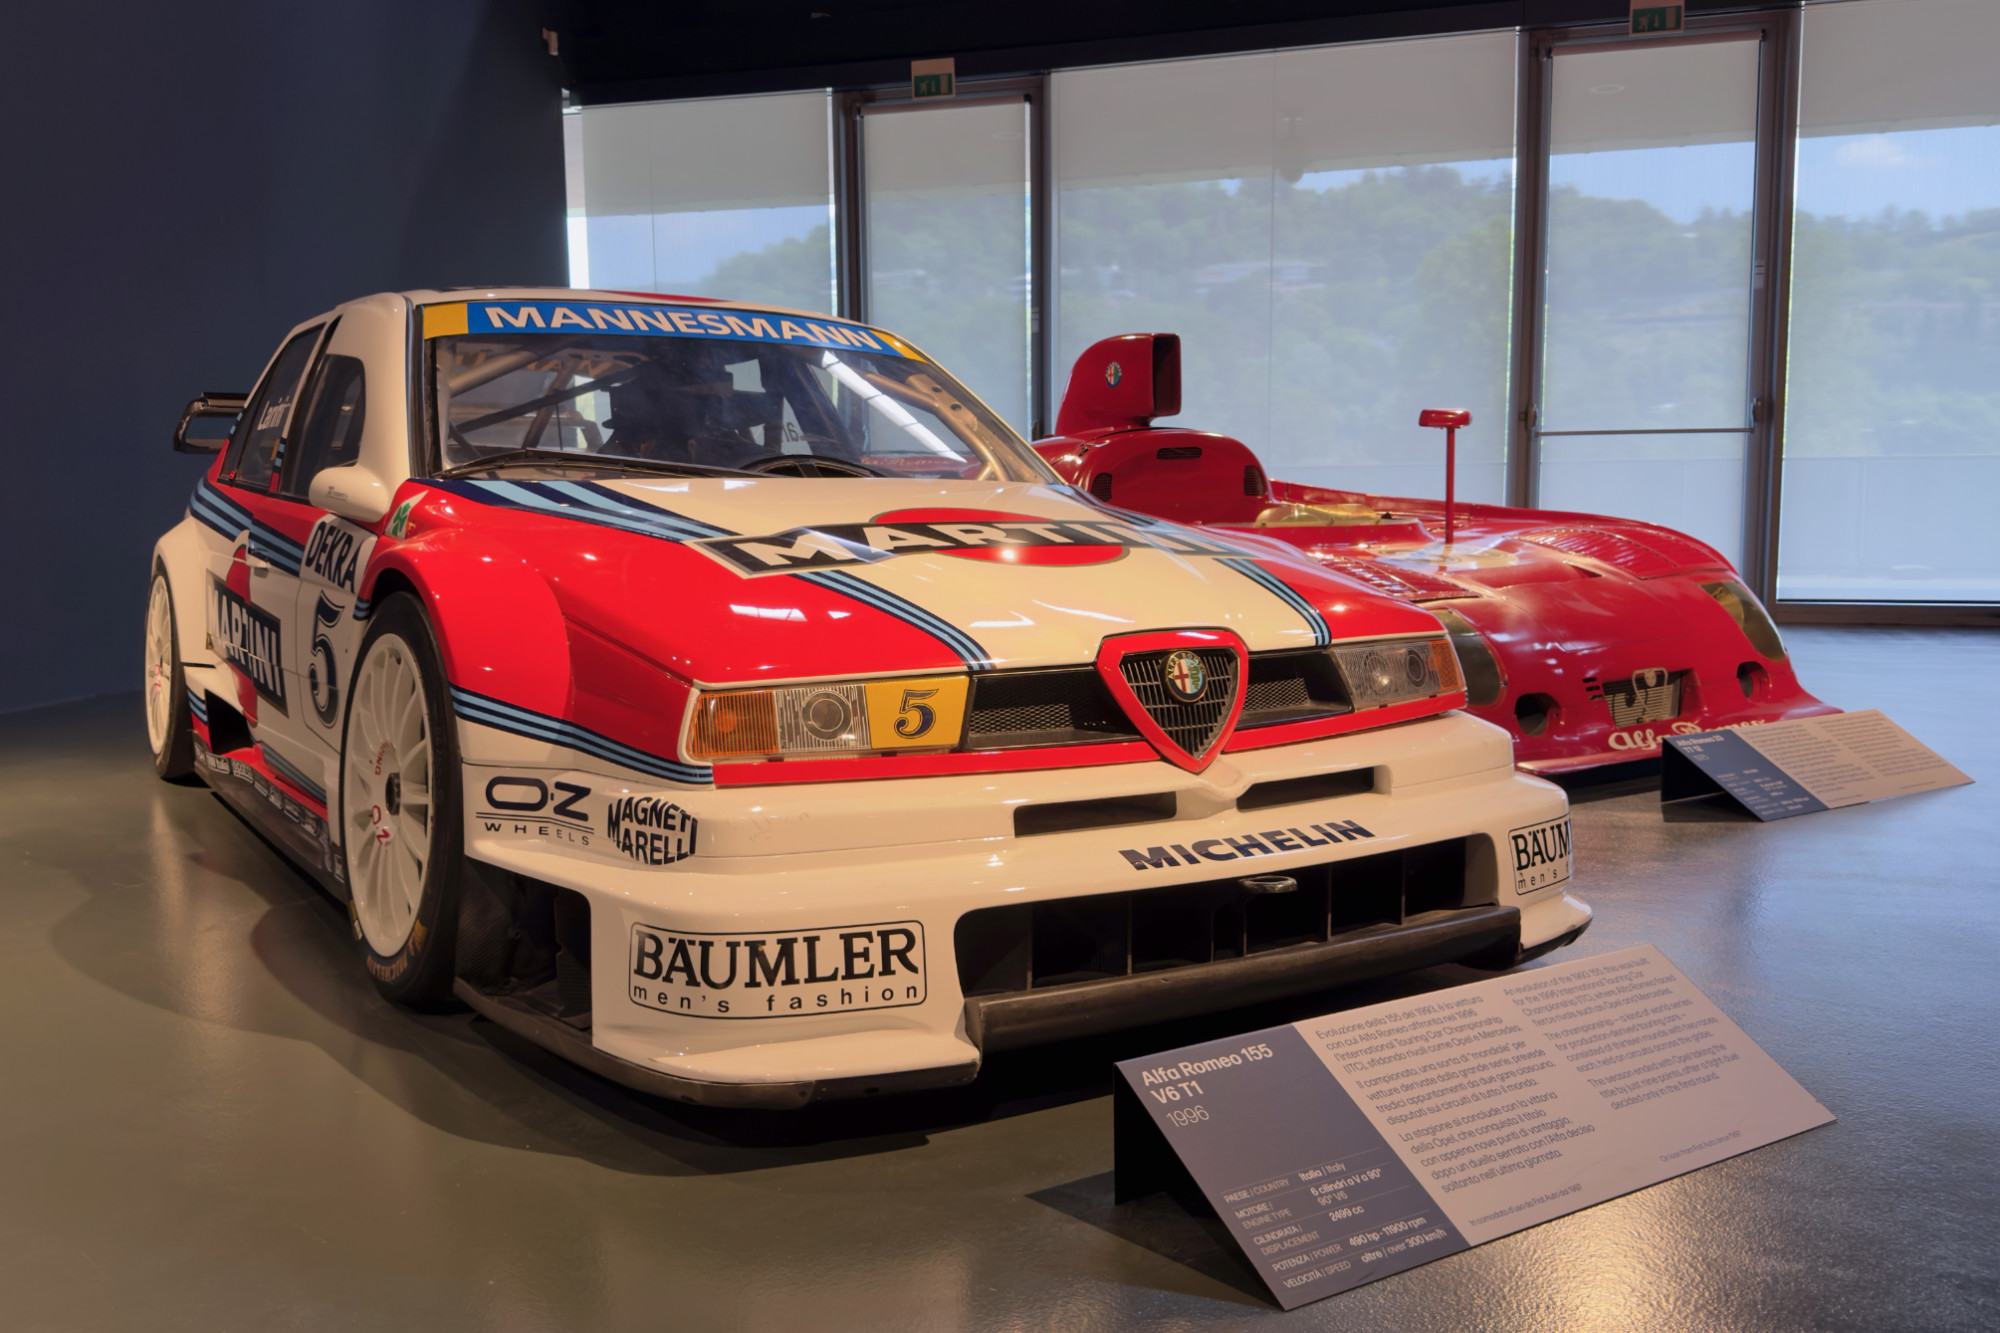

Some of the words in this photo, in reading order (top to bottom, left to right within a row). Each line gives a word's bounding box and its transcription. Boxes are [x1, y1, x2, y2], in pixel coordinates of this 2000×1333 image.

[485, 306, 883, 350] MANNESMANN
[305, 521, 357, 594] DEKRA
[735, 520, 1229, 567] MARTINI
[207, 583, 286, 699] MARTINI
[308, 590, 346, 728] 5
[893, 688, 939, 740] 5
[484, 822, 590, 847] WHEELS
[607, 797, 698, 843] MAGNETI
[607, 812, 698, 865] MARELLI
[1119, 820, 1376, 871] MICHELIN
[632, 926, 920, 989] BÄUMLER
[632, 983, 730, 1014] men's
[767, 984, 919, 1011] fashion
[1142, 1068, 1180, 1086] Alfa
[1179, 1054, 1242, 1076] Romeo
[1241, 1044, 1273, 1062] 155
[1151, 1086, 1181, 1103] V6
[1179, 1081, 1203, 1097] T1
[1413, 1122, 1452, 1137] stagione
[1461, 1108, 1501, 1123] conclude
[1501, 1103, 1518, 1112] con
[1526, 1091, 1557, 1104] vittoria
[1168, 1106, 1210, 1127] 1996
[1409, 1142, 1434, 1154] della
[1457, 1130, 1475, 1140] che
[1475, 1118, 1518, 1134] conquista
[1522, 1109, 1546, 1120] titolo
[1421, 1156, 1439, 1166] con
[1439, 1146, 1475, 1161] appena
[1474, 1139, 1497, 1150] nove
[1496, 1130, 1520, 1145] punti
[1430, 1167, 1456, 1179] dopo
[1467, 1154, 1496, 1167] duello
[1496, 1145, 1528, 1159] serrato
[1528, 1140, 1546, 1149] con
[1564, 1124, 1594, 1137] deciso
[1299, 1170, 1321, 1180] Italia
[1325, 1163, 1346, 1172] Italy
[1318, 1179, 1348, 1193] cilindri
[1441, 1176, 1480, 1192] soltanto
[1329, 1208, 1352, 1220] 2499
[1334, 1191, 1348, 1200] V6
[1272, 1254, 1310, 1271] POTENZA
[1348, 1235, 1367, 1246] 490
[1383, 1222, 1408, 1235] 11900
[1408, 1218, 1425, 1228] rpm
[1362, 1251, 1382, 1262] oltre
[1406, 1236, 1424, 1247] 300
[1423, 1228, 1446, 1241] km/h
